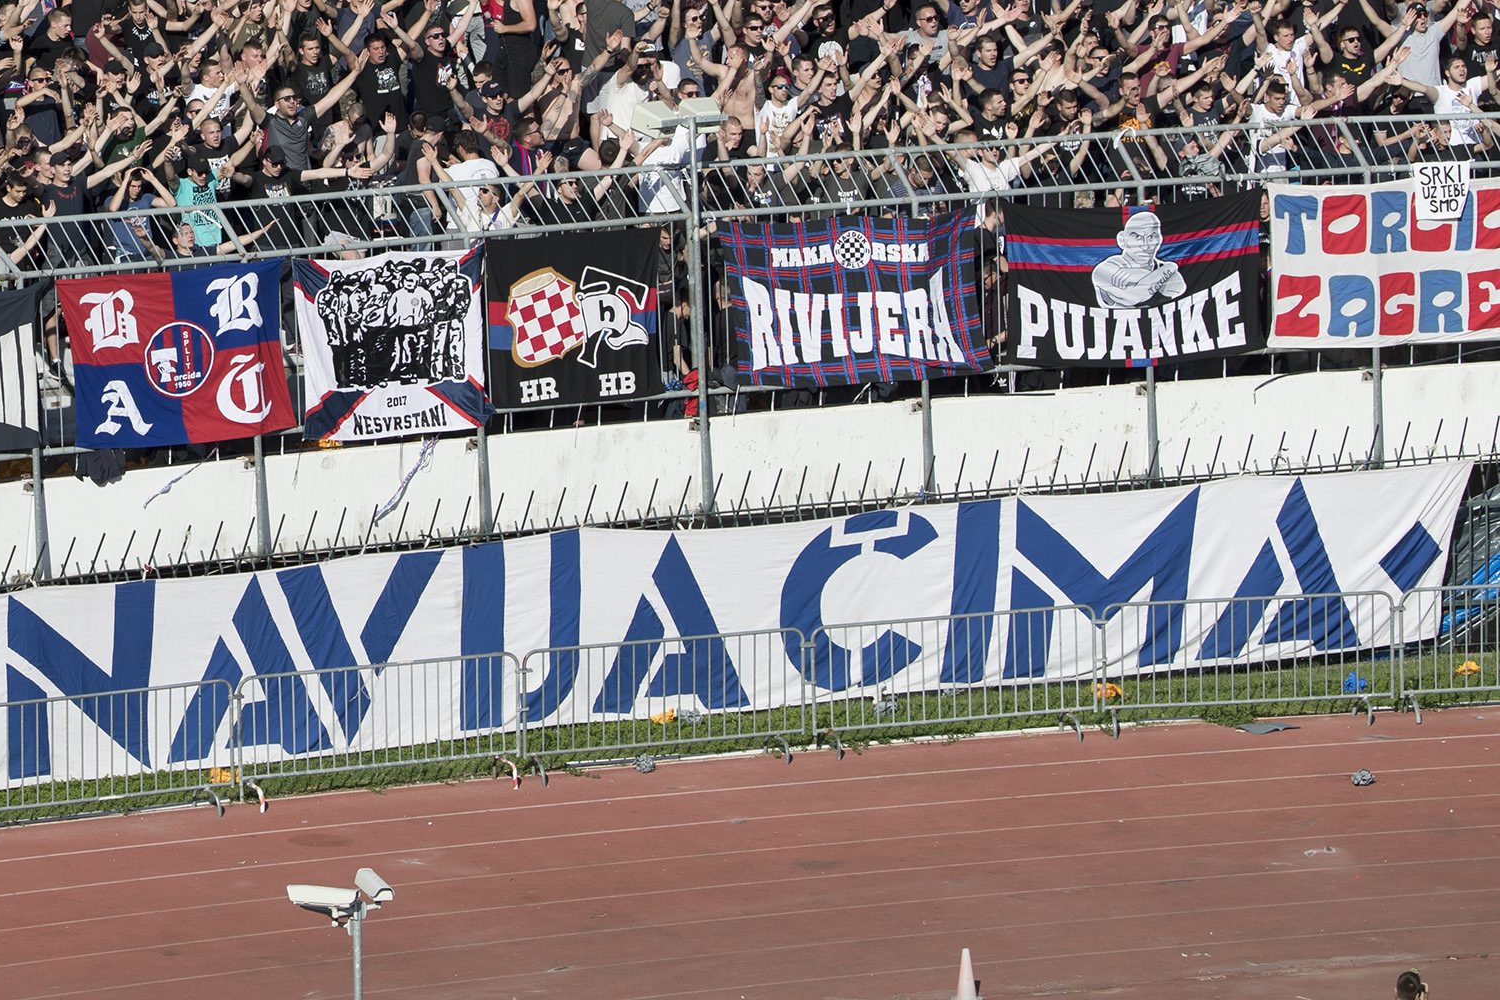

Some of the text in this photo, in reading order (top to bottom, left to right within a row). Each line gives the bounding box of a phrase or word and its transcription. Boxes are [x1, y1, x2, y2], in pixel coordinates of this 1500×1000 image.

[1419, 164, 1463, 186] SRKI
[1422, 183, 1467, 200] UZ TEBE
[1429, 199, 1459, 213] SMO
[835, 230, 870, 250] HAJDUK
[771, 241, 930, 268] MAKA RSKA
[840, 256, 868, 269] SPLIT
[79, 272, 264, 353] B B
[741, 266, 966, 371] RIVIJERA
[1016, 270, 1248, 361] PUJANKE
[181, 330, 191, 376] SPLIT
[174, 379, 193, 389] 1950
[518, 371, 637, 404] HR HB
[94, 379, 154, 436] A
[386, 394, 408, 408] 2017
[352, 404, 448, 437] NESVRSTANI
